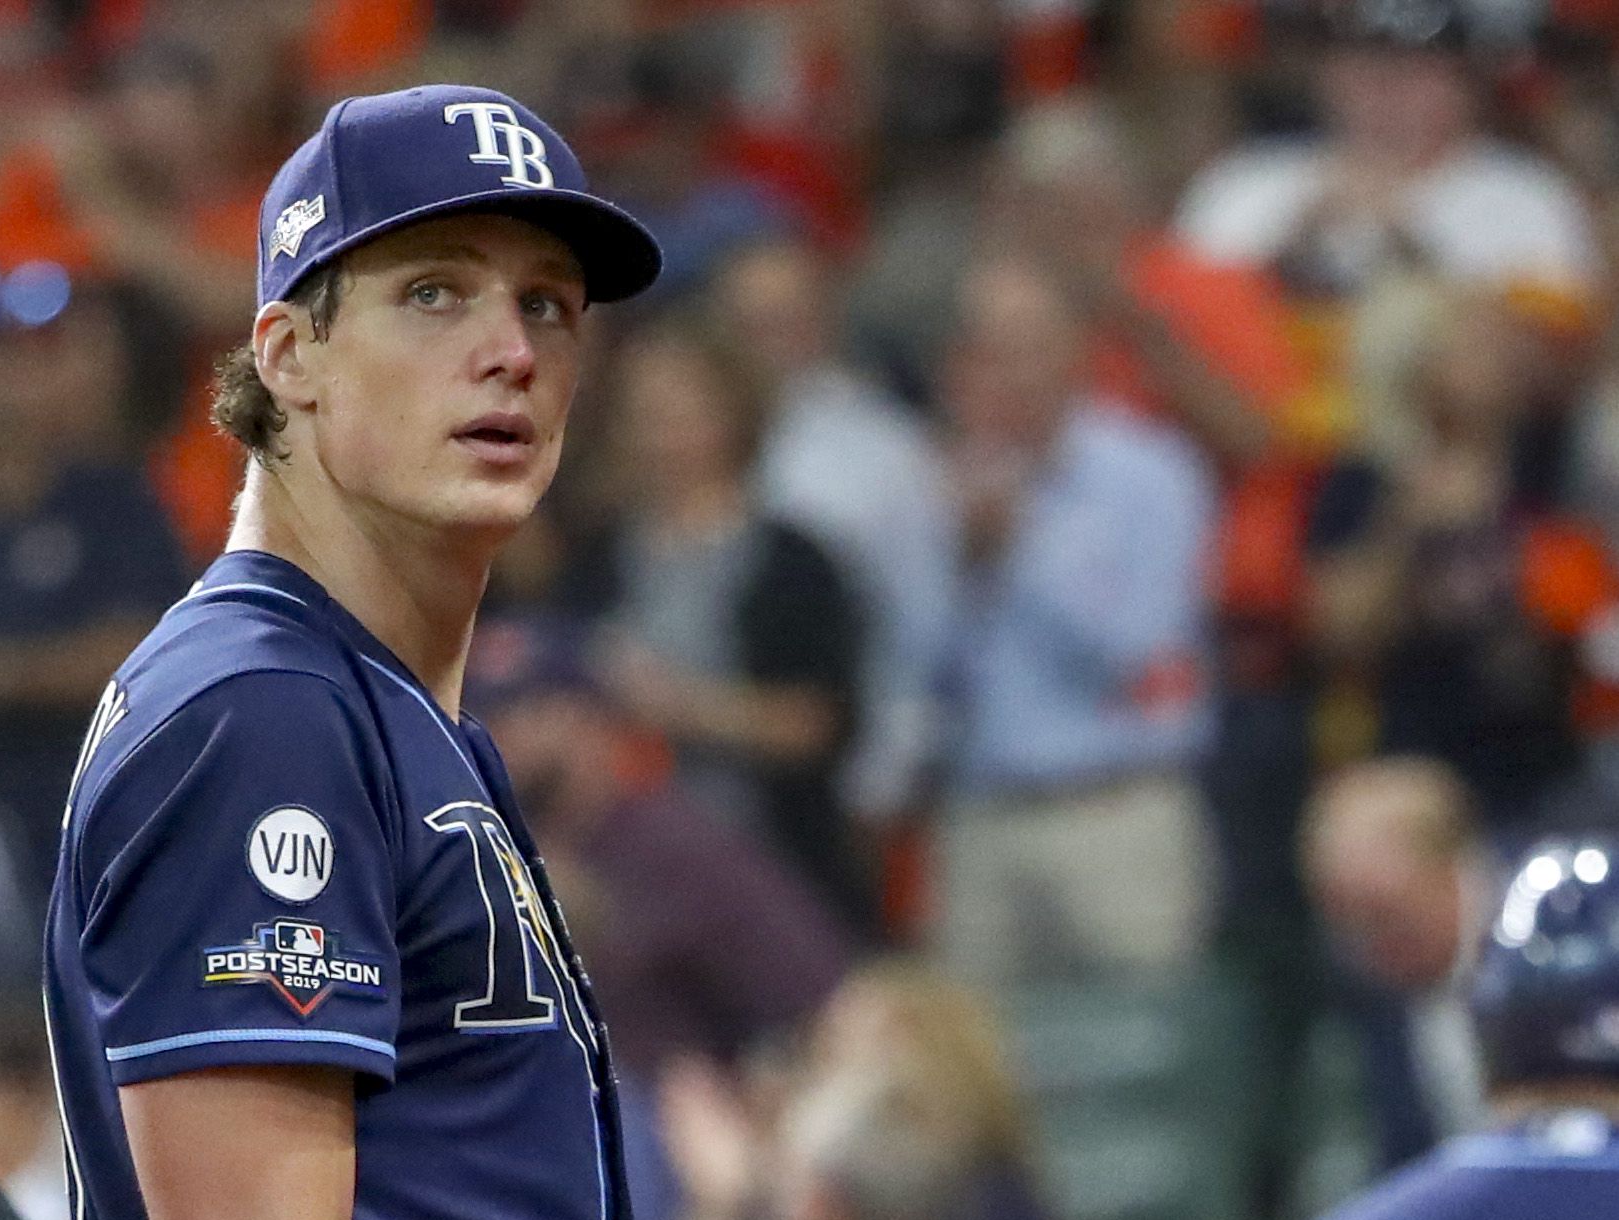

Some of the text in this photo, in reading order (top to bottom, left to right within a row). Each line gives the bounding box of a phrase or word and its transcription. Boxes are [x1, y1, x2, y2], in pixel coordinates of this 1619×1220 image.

[443, 102, 555, 189] TB
[259, 830, 326, 880] VJN
[207, 952, 380, 986] POSTSEASON
[283, 975, 321, 989] 2019
